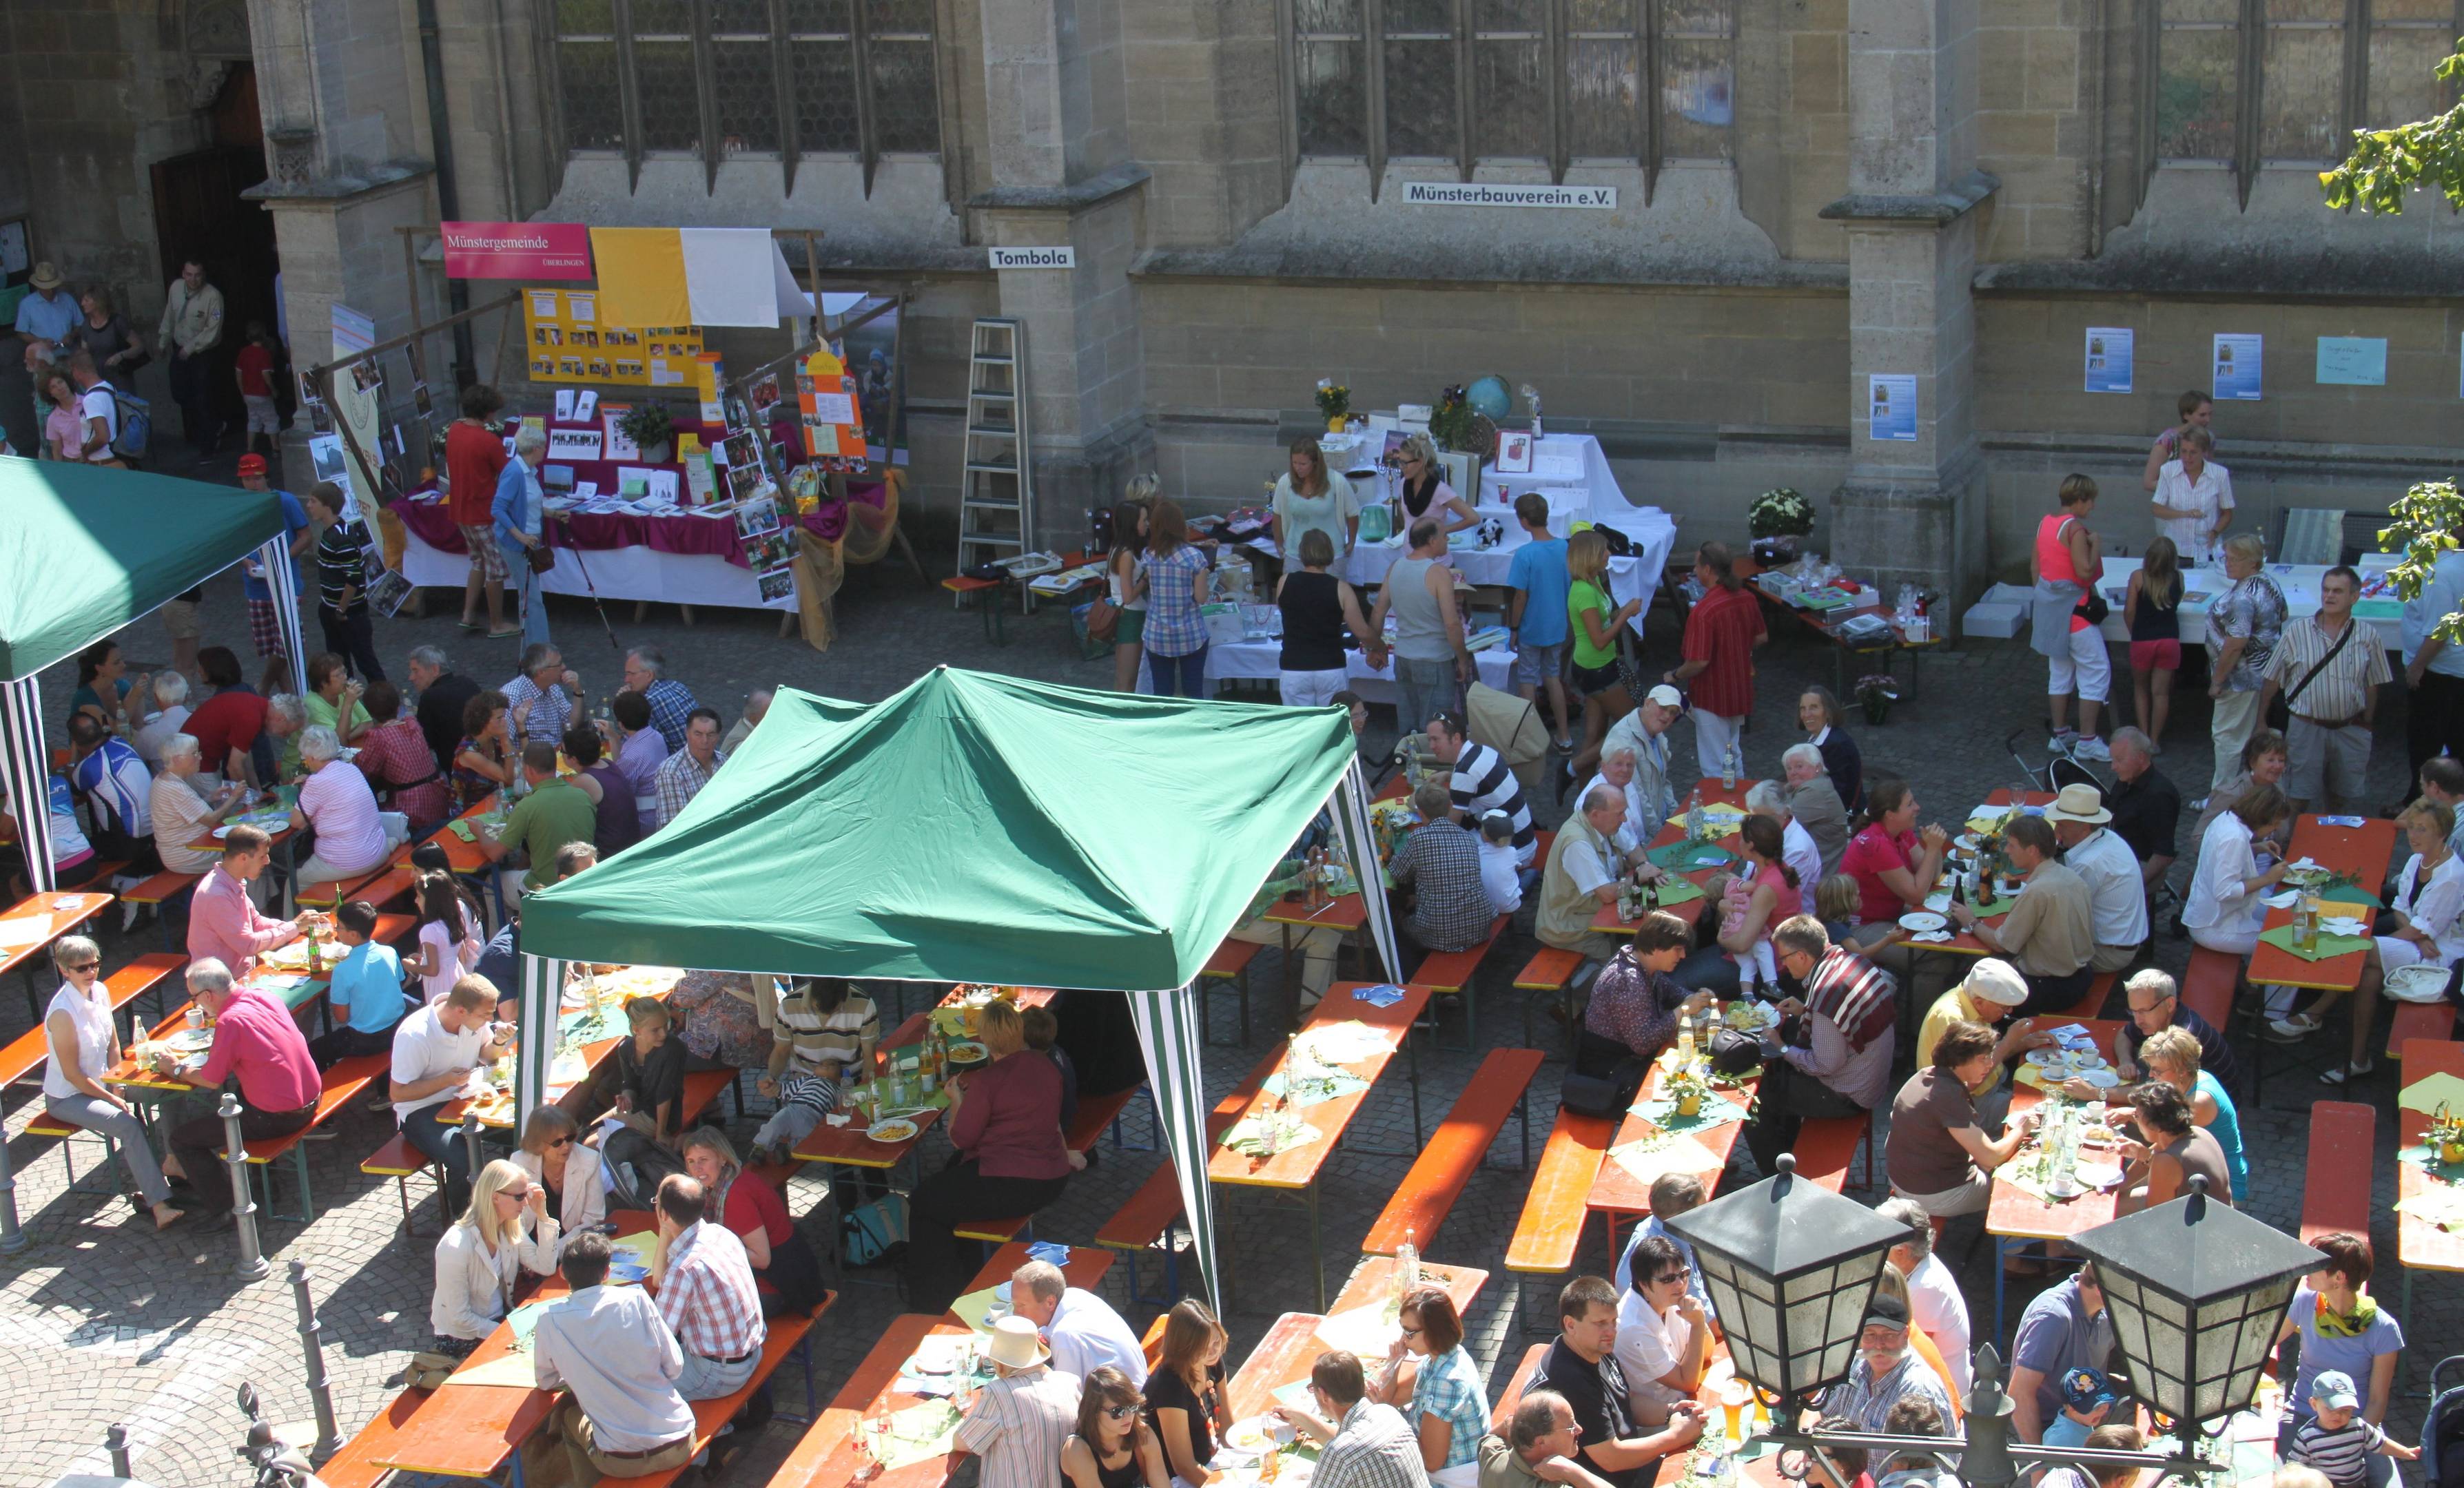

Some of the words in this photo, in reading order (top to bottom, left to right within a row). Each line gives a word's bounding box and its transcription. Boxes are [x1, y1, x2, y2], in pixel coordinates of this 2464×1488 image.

[1410, 185, 1572, 205] Münsterbauverein
[1578, 190, 1610, 205] e.V.
[447, 235, 548, 251] Münstergemeinde
[542, 258, 584, 267] ÜBERLINGEN
[995, 249, 1067, 265] Tombola
